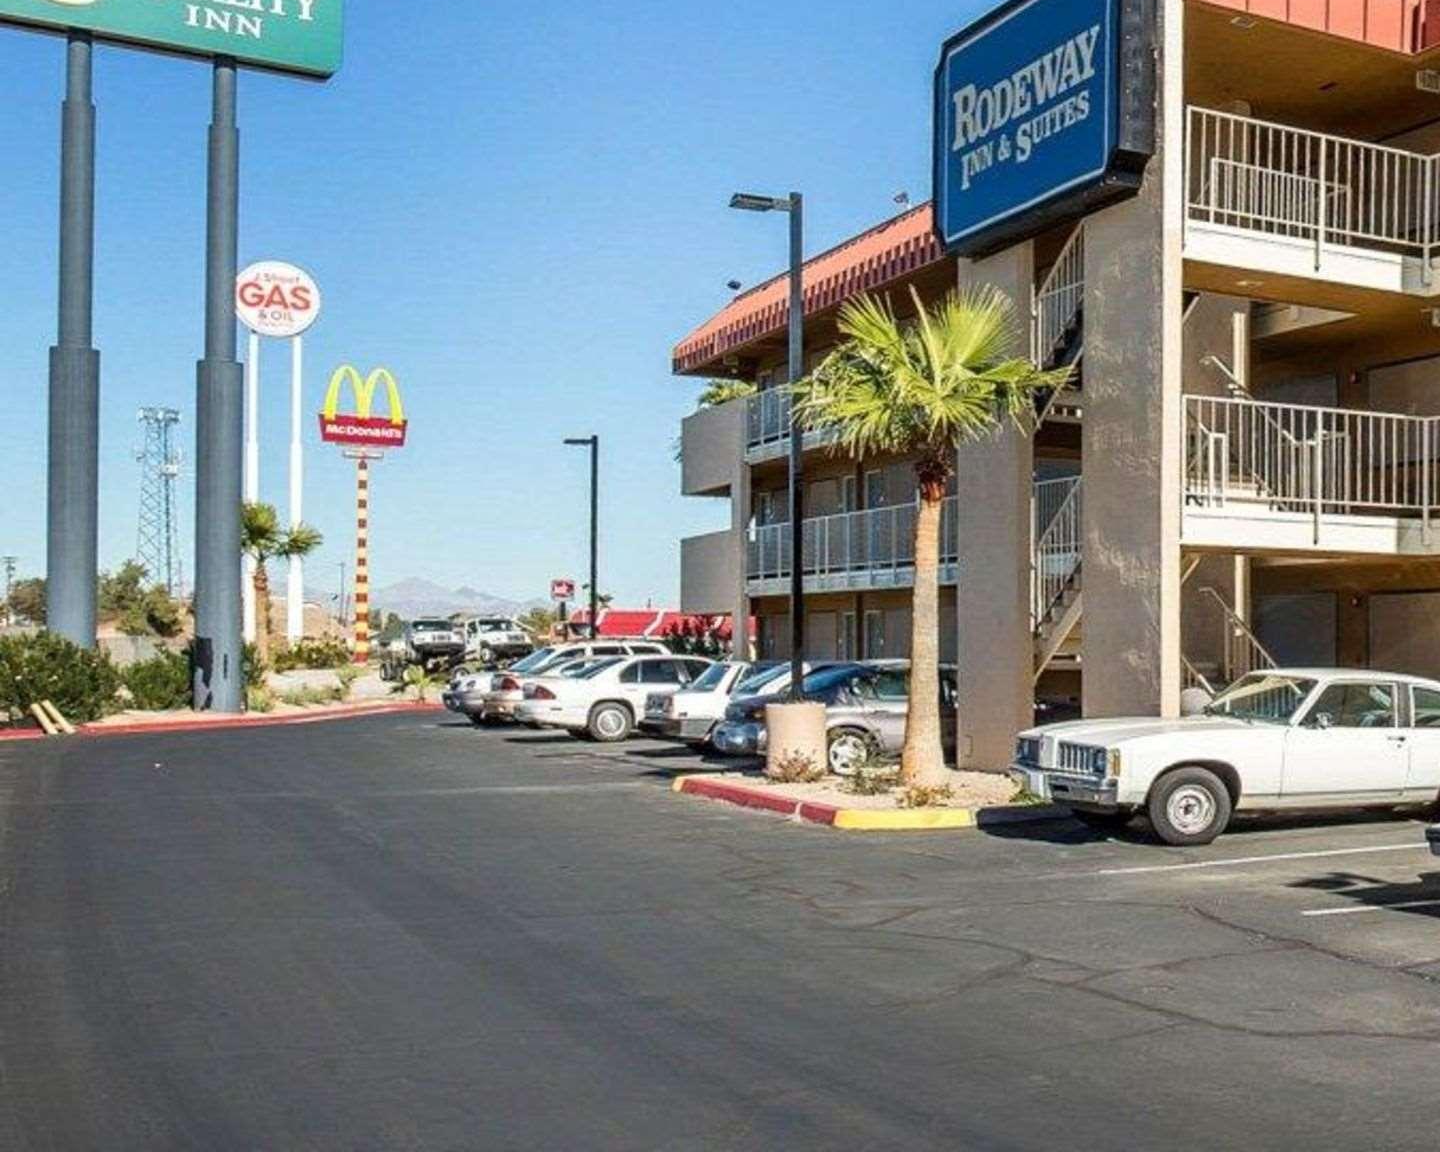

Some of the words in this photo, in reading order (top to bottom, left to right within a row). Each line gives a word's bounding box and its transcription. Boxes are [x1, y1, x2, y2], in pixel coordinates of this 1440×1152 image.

[185, 3, 263, 39] INN
[952, 24, 1100, 151] RODEWAY
[960, 140, 993, 190] INN
[998, 134, 1011, 161] &
[1015, 90, 1090, 163] SUITES
[239, 282, 311, 310] GAS
[270, 310, 296, 322] OIL
